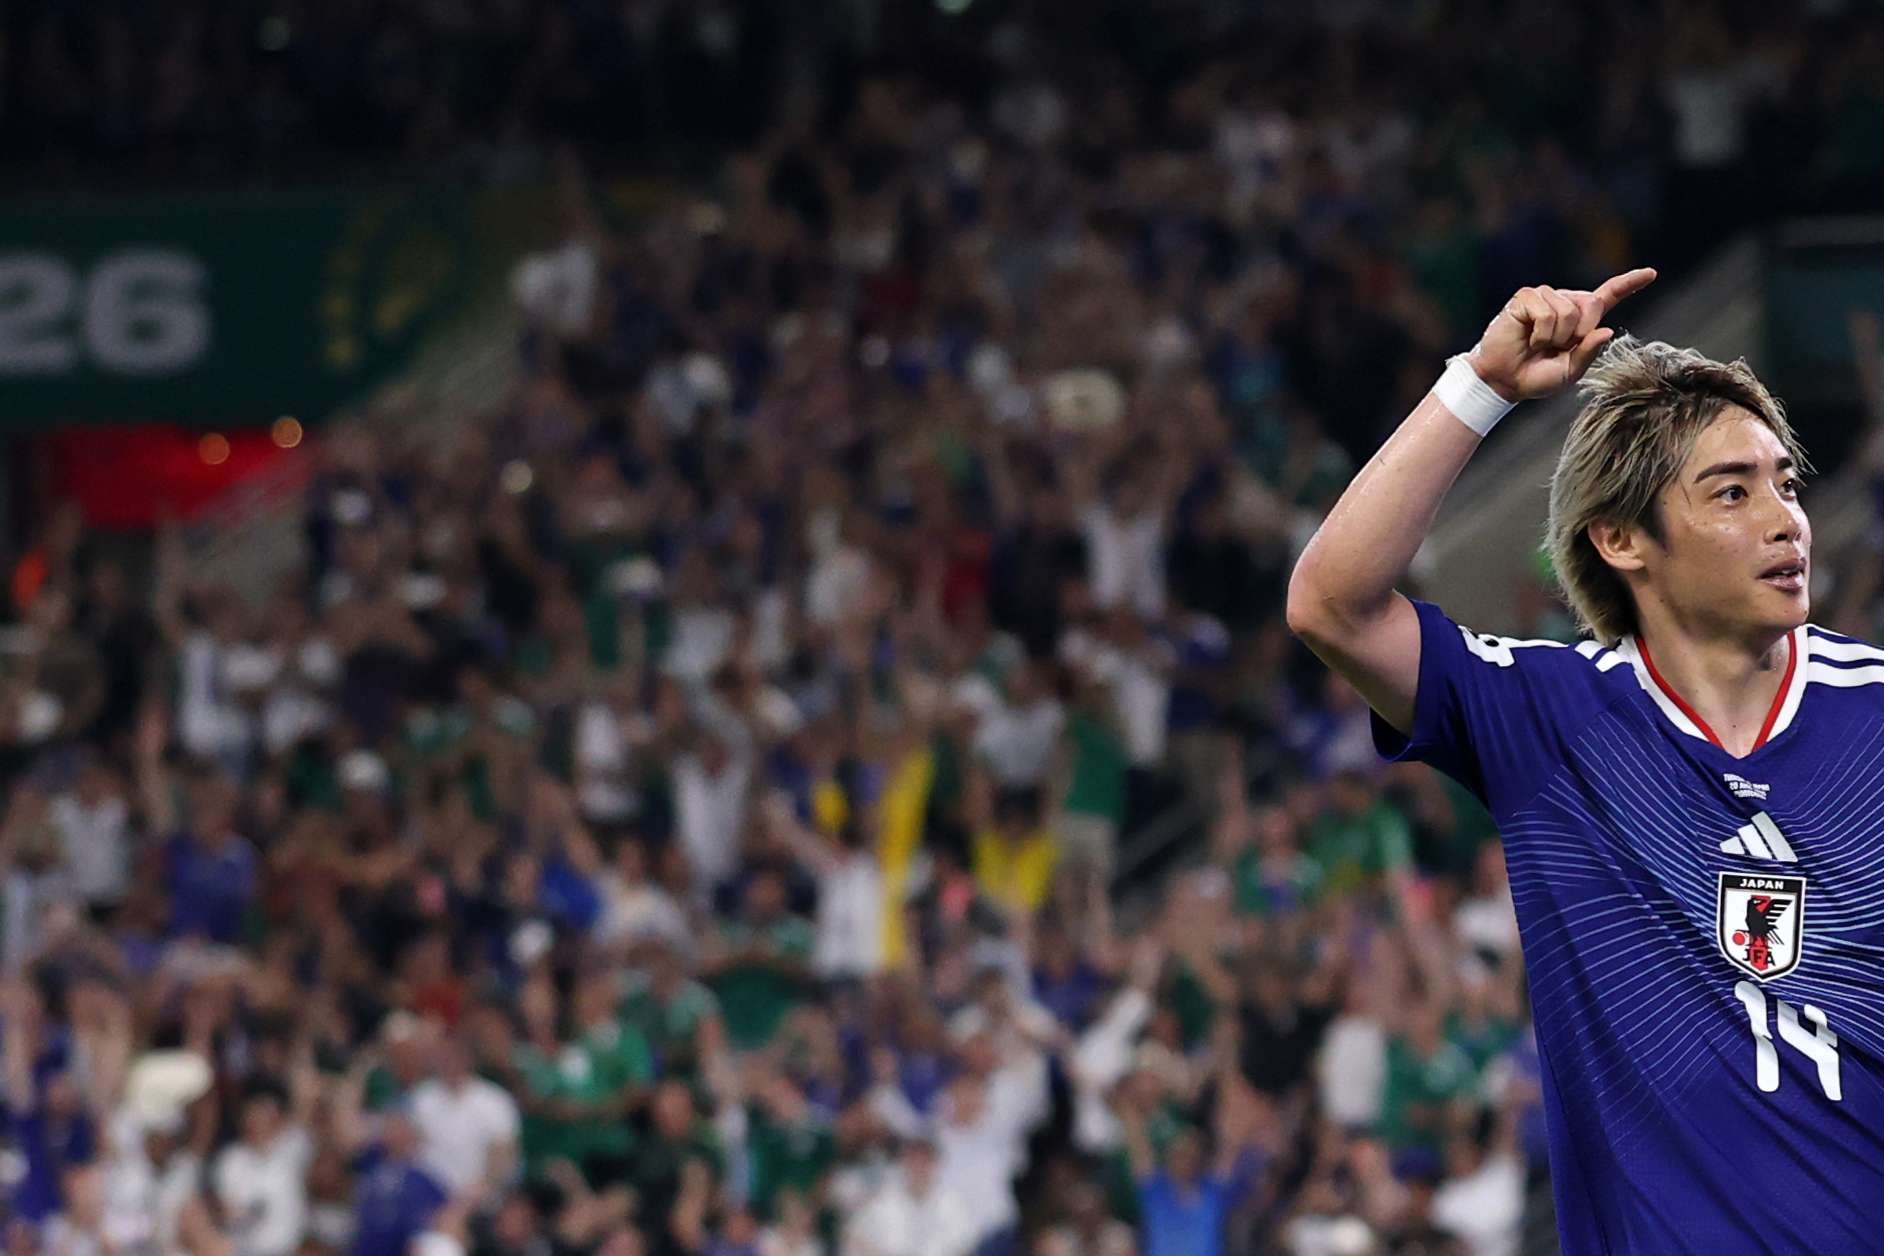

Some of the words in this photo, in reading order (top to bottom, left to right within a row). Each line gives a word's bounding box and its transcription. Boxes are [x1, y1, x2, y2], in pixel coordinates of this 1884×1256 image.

[0, 251, 211, 373] 26
[1740, 878, 1784, 891] JAPAN
[1742, 946, 1776, 966] JFA
[1734, 980, 1842, 1101] 14
